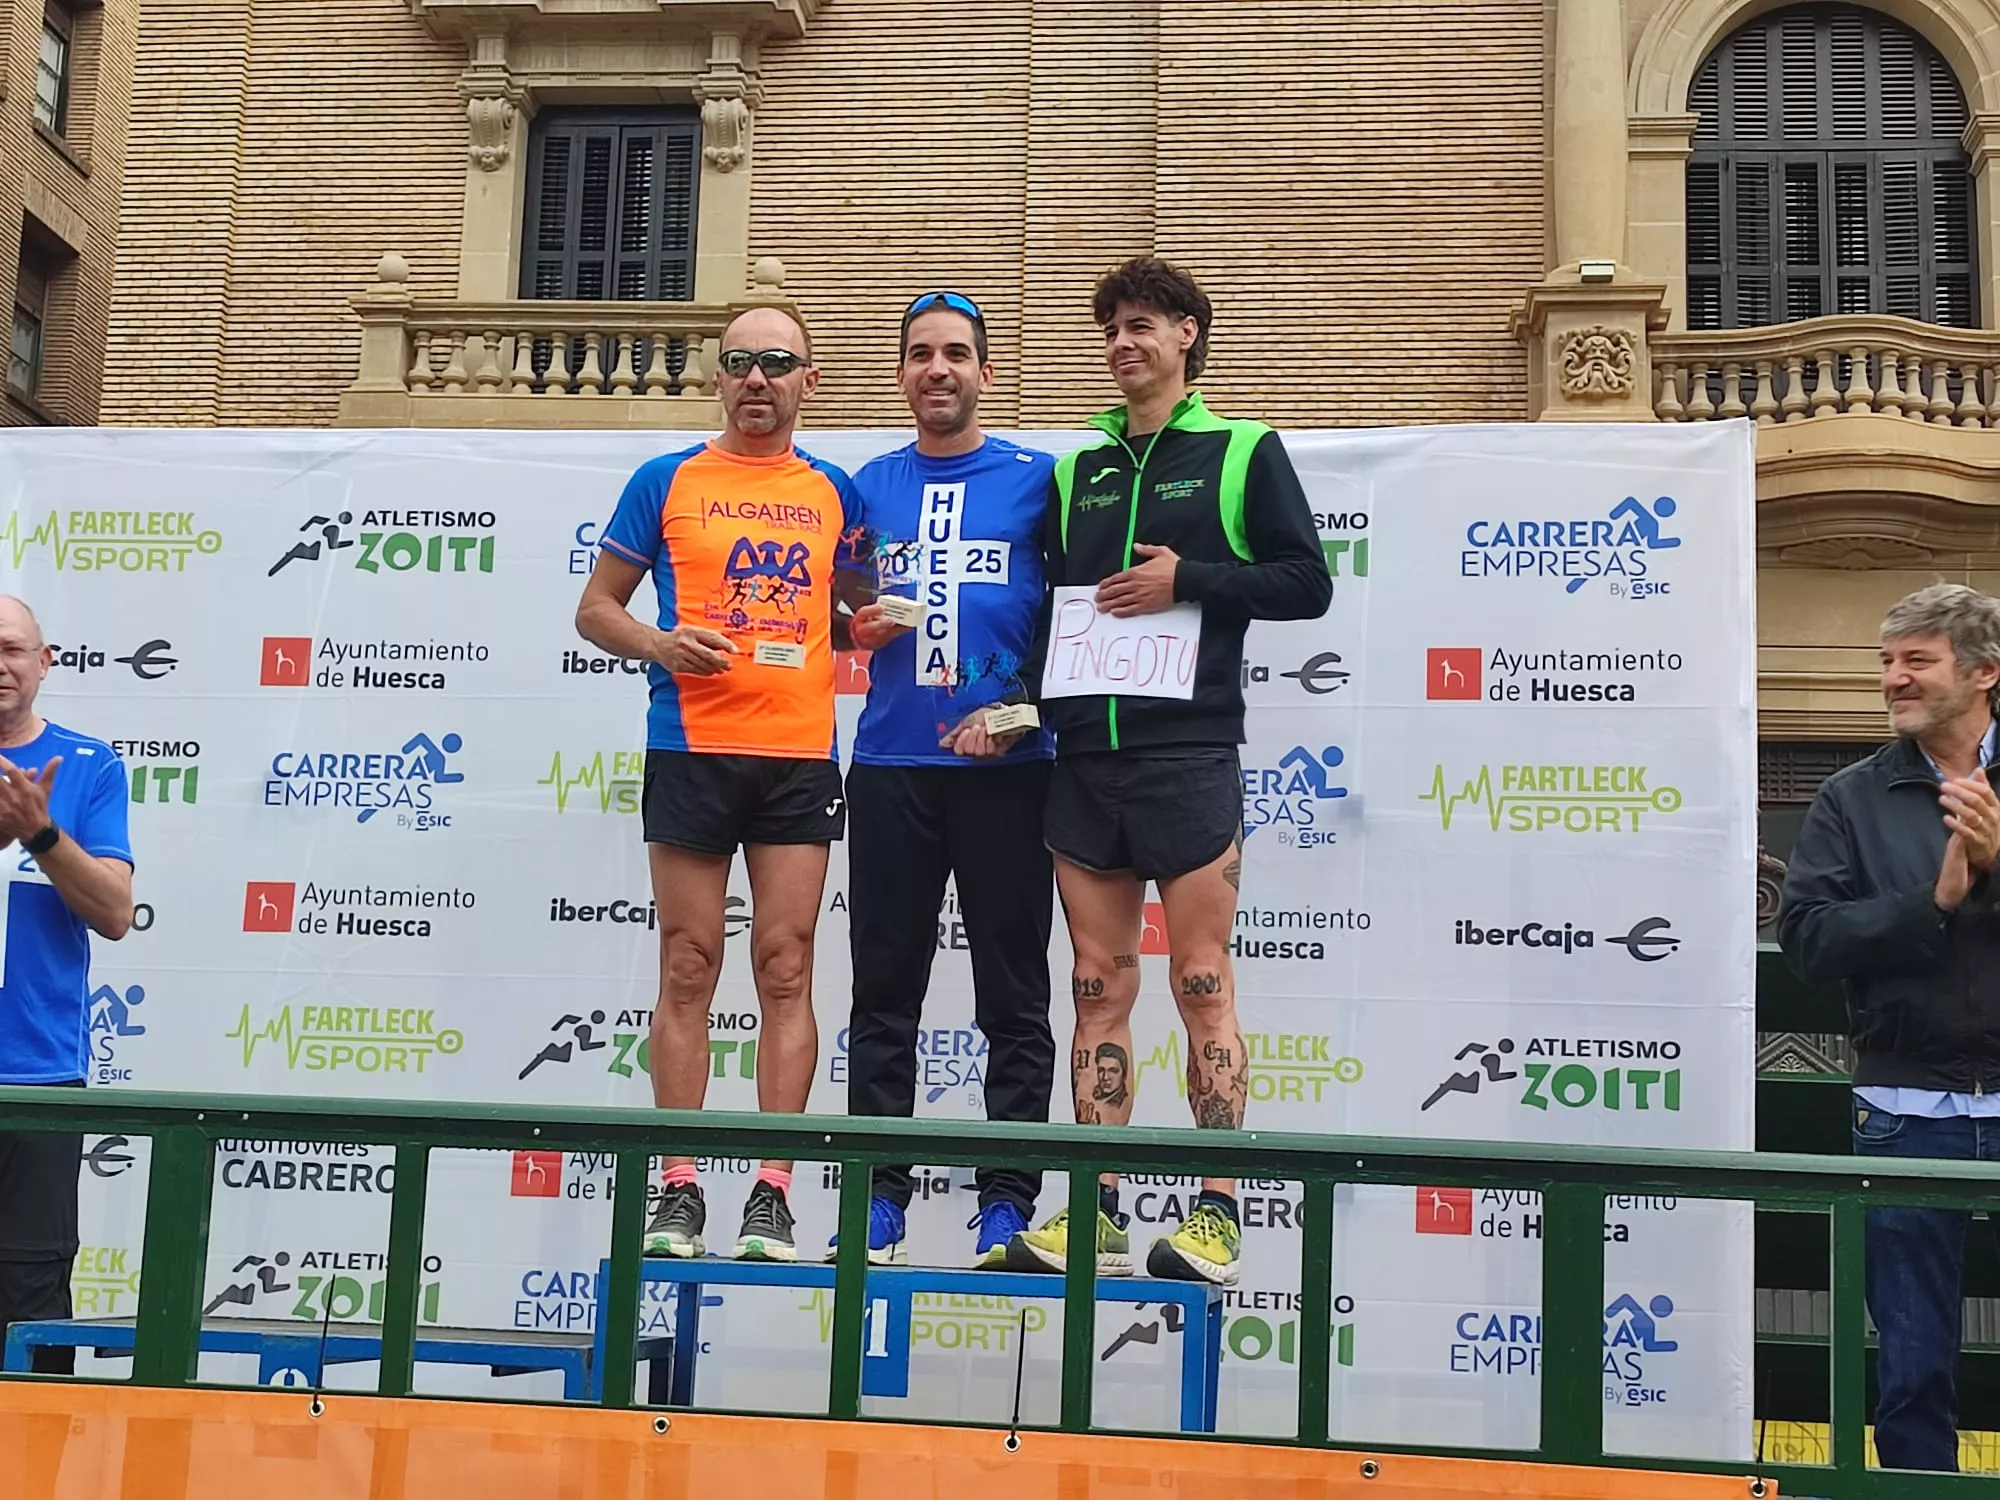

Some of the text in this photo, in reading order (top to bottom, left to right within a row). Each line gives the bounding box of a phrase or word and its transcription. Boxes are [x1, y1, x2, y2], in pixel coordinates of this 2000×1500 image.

[68, 510, 194, 536] FARTLECK
[361, 510, 496, 528] ATLETISMO
[1467, 520, 1641, 548] CARRERA
[71, 546, 187, 572] SPORT
[355, 532, 496, 574] ZOITI
[965, 548, 1002, 574] 25
[1461, 550, 1647, 577] EMPRESAS
[925, 491, 954, 673] HUESCA
[1610, 582, 1628, 598] By
[318, 637, 489, 663] Ayuntamiento
[562, 651, 649, 674] iberC
[1489, 647, 1683, 677] Ayuntamiento
[316, 666, 445, 690] de Huesca
[1489, 679, 1635, 702] de Huesca
[111, 740, 200, 758] ETISMO
[272, 752, 430, 779] CARRERA
[1502, 765, 1647, 792] FARTLECK
[131, 764, 198, 804] ITI
[264, 781, 432, 809] EMPRESAS
[397, 813, 413, 829] By
[1508, 805, 1648, 833] SPORT
[1278, 831, 1295, 846] By
[301, 882, 476, 909] Ayuntamiento
[298, 913, 431, 937] de Huesca
[550, 898, 655, 930] iberCaj
[1235, 905, 1371, 930] ntamiento
[1455, 920, 1594, 954] iberCaja
[302, 1005, 434, 1035] FARTLECK
[305, 1046, 432, 1074] SPORT
[1245, 1033, 1330, 1062] TLECK
[1525, 1038, 1681, 1060] ATLETISMO
[1248, 1074, 1330, 1103] ORT
[1520, 1063, 1681, 1111] ZOITI
[567, 1176, 596, 1200] de
[1480, 1213, 1512, 1238] de
[864, 1298, 889, 1357] 1
[911, 1320, 1014, 1351] PORT
[1605, 1386, 1623, 1403] By
